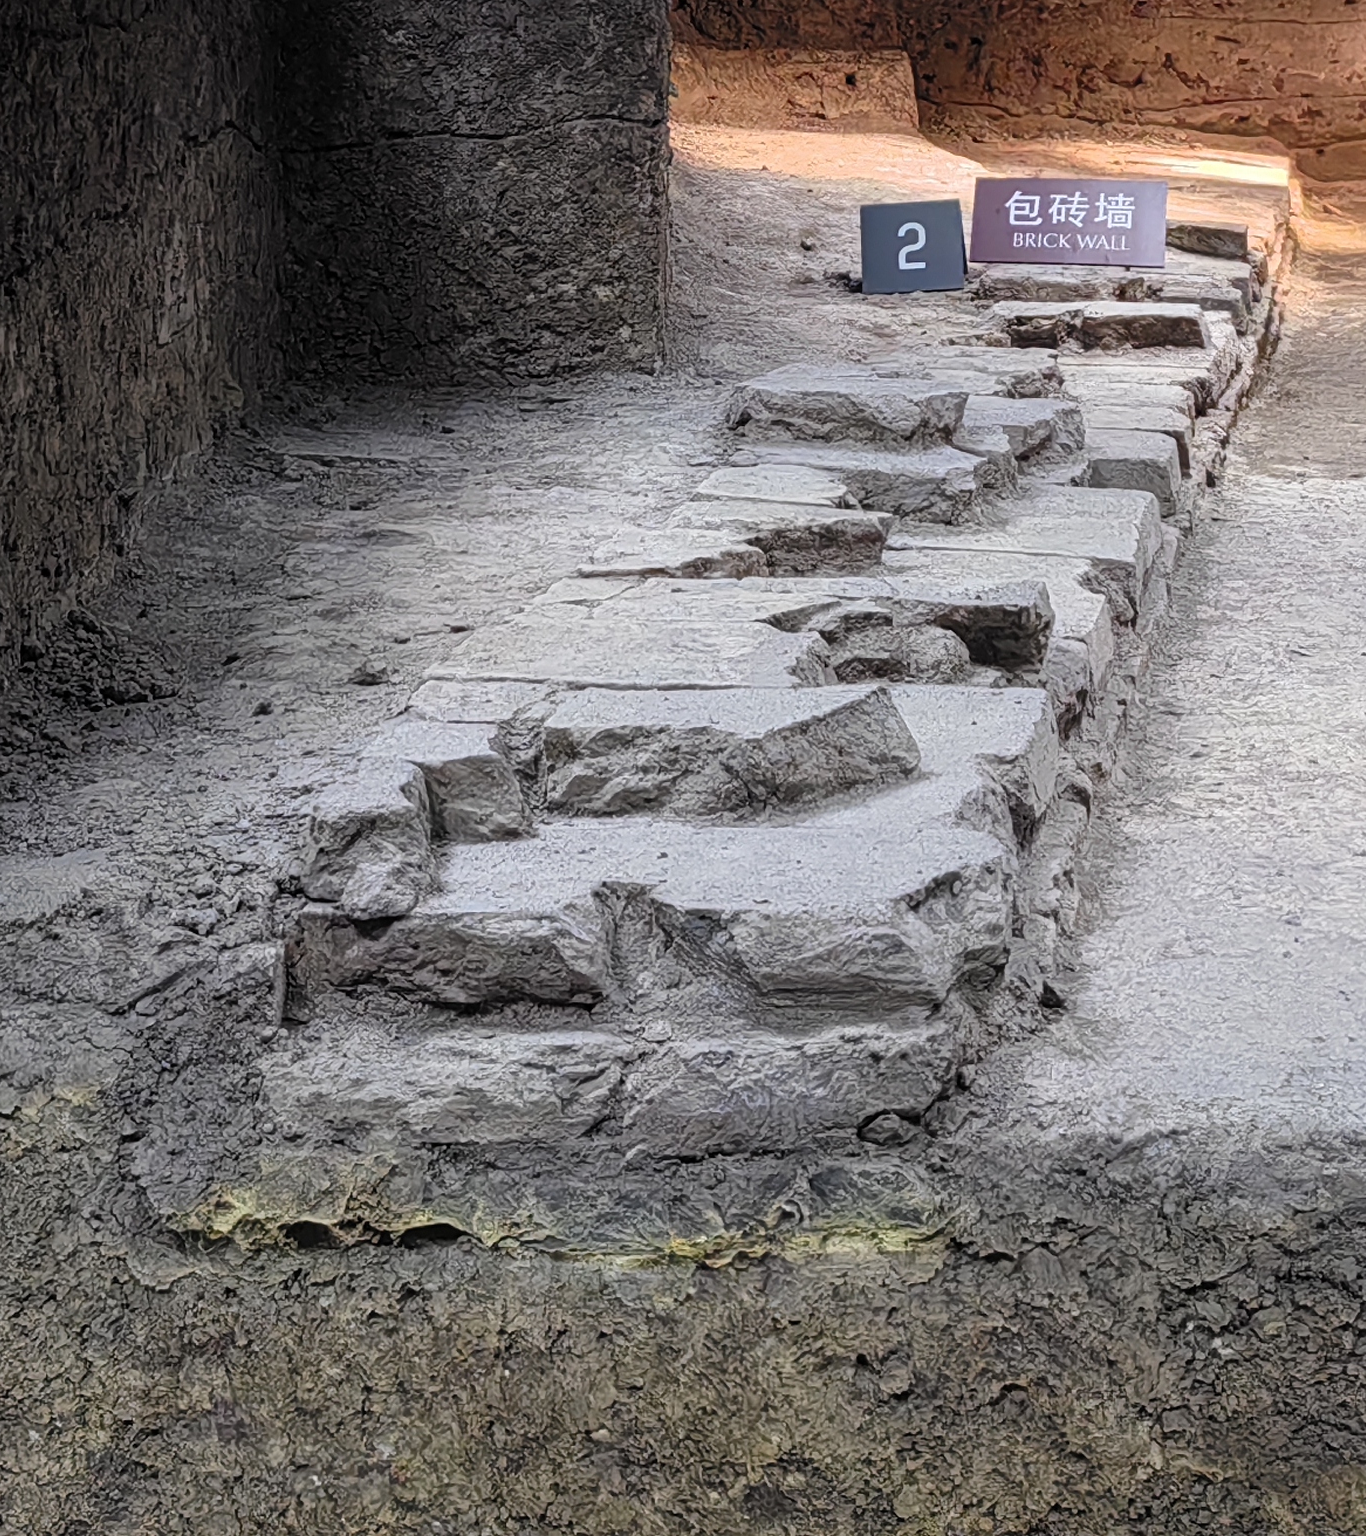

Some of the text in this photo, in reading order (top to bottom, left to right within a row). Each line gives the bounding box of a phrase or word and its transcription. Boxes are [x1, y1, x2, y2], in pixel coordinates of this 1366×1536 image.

[1005, 190, 1136, 229] 包砖墙
[897, 221, 927, 270] 2
[1013, 232, 1131, 251] BRICK WALL
